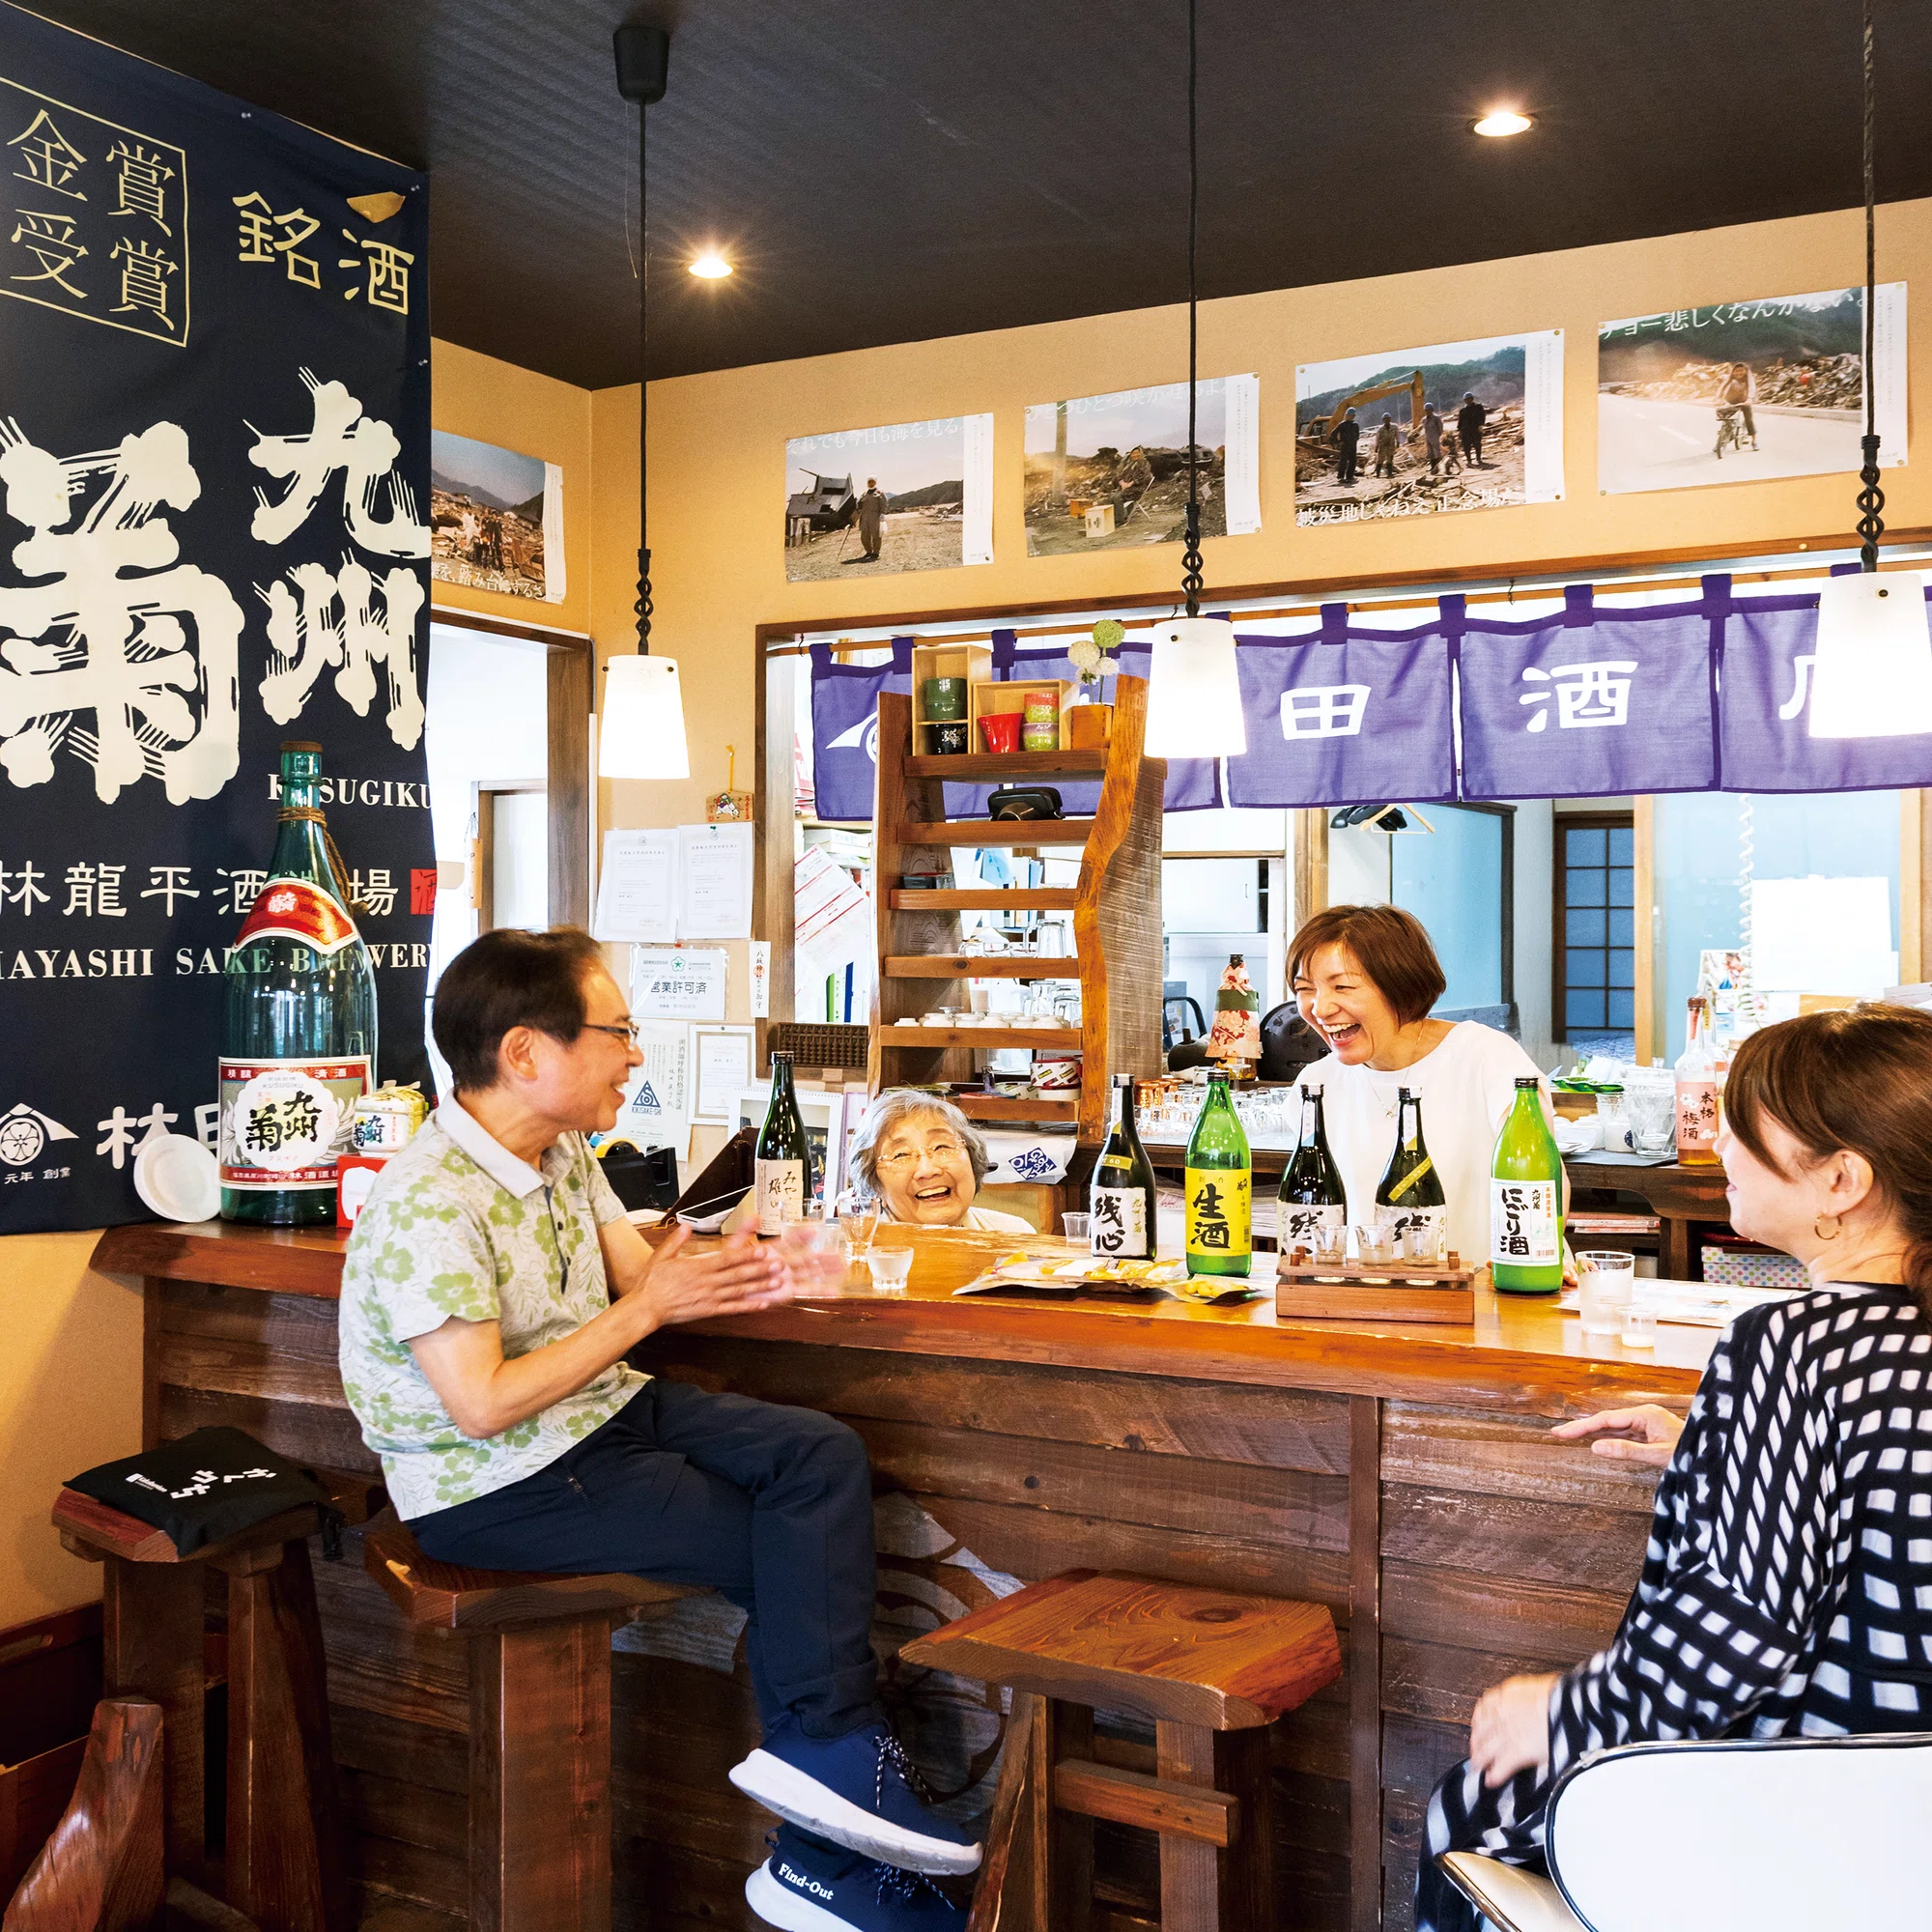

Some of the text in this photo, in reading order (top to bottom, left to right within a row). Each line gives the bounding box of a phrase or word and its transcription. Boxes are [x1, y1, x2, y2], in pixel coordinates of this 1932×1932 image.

[7, 108, 176, 238] 金賞
[10, 208, 180, 331] 受賞
[232, 190, 415, 316] 銘酒
[268, 773, 432, 810] KSUGIKU
[0, 860, 399, 917] 林龍平酒場
[0, 948, 155, 980] AYASHI
[176, 947, 272, 976] SAKE
[244, 1103, 284, 1152] 菊
[283, 1090, 323, 1143] 九州
[1682, 1111, 1701, 1140] 梅酒
[4, 1171, 35, 1185] 元年
[1190, 1182, 1231, 1249] 生酒
[1499, 1187, 1530, 1256] にごり酒
[778, 1862, 835, 1901] Find-Out
